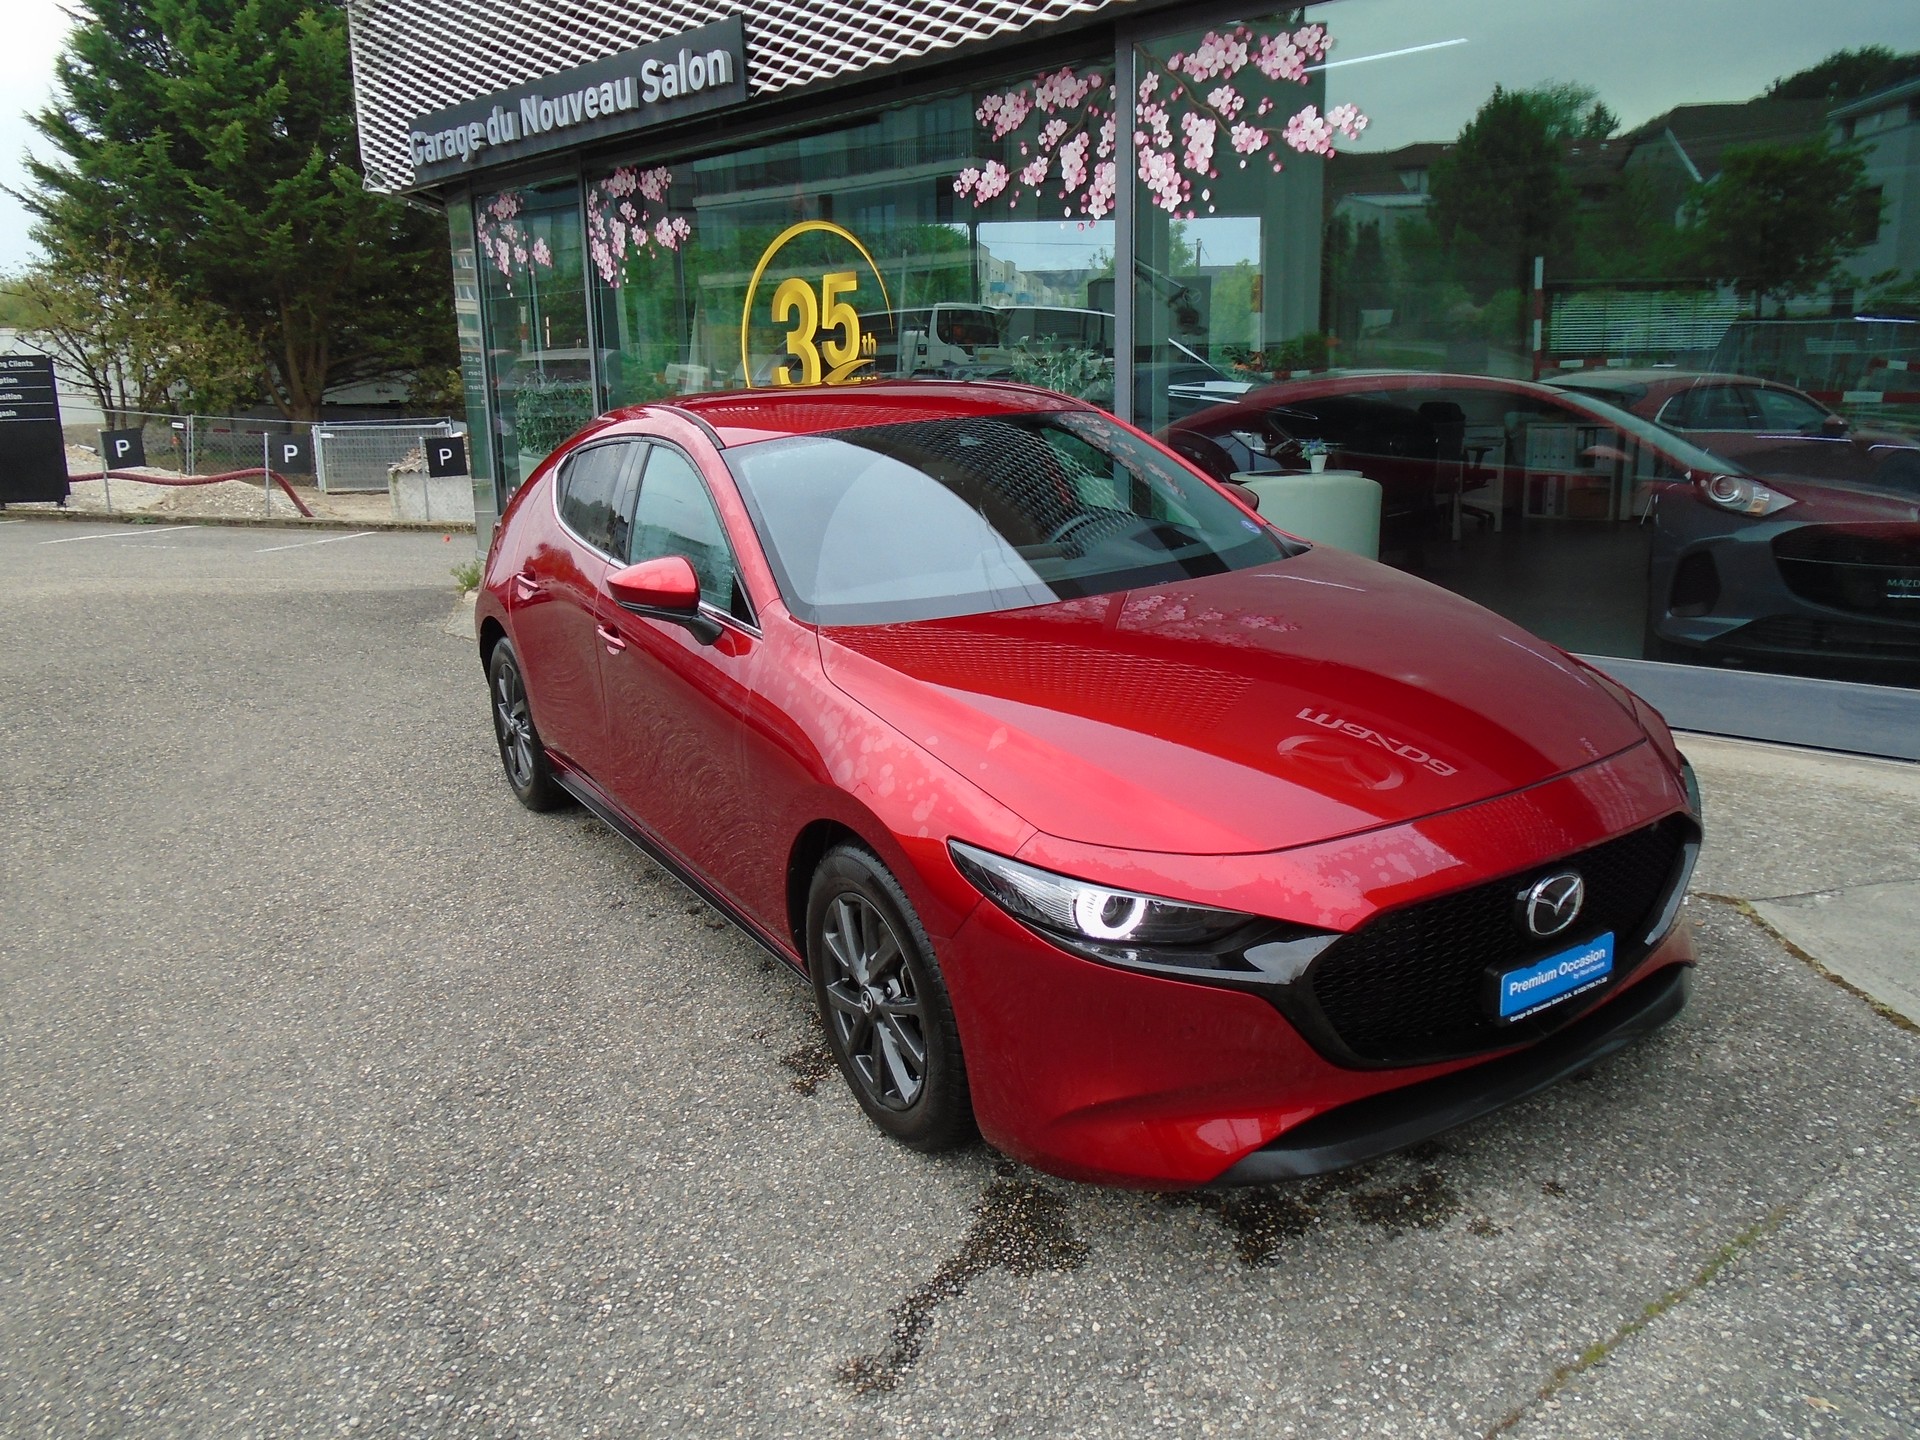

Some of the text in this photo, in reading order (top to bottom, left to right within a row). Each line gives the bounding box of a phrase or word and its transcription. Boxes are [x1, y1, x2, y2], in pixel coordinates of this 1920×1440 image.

[411, 48, 733, 166] Garage du Nouveau Salon
[115, 439, 130, 458] P
[283, 444, 298, 463] P
[438, 448, 452, 467] P
[1509, 948, 1606, 996] Premium Occasion
